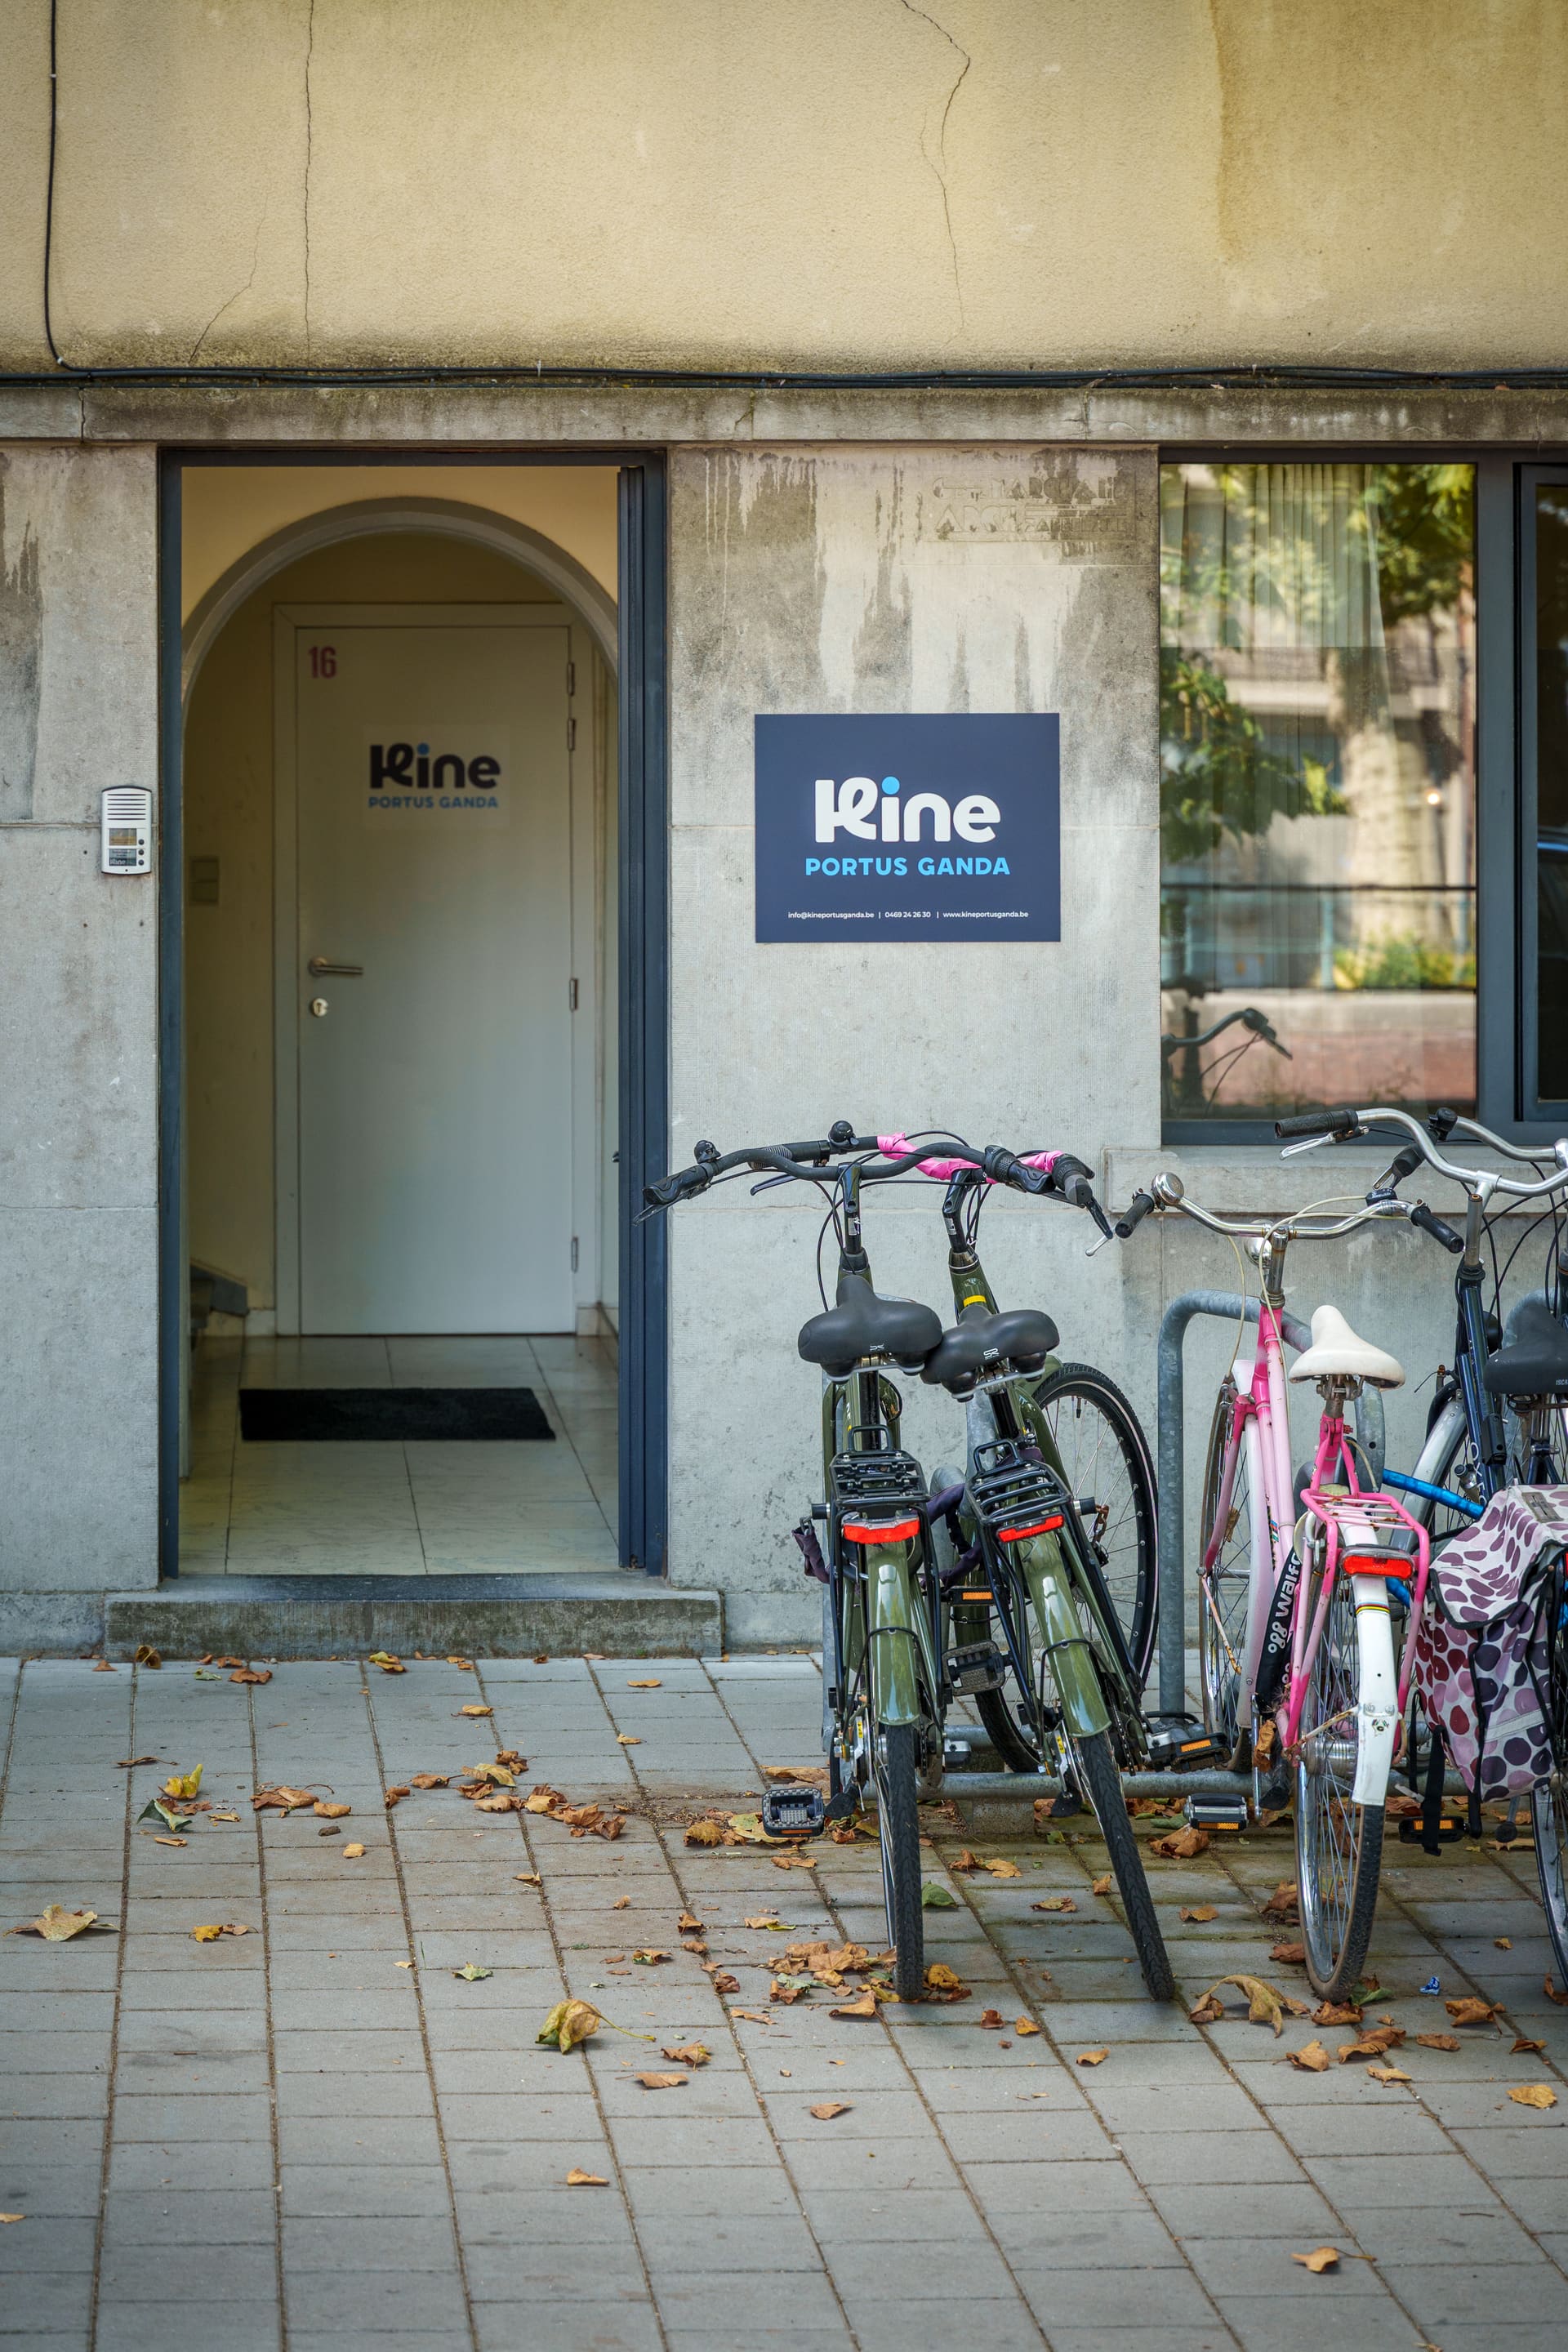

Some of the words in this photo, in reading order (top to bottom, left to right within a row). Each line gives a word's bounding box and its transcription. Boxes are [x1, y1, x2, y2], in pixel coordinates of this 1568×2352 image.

[309, 646, 337, 679] 16
[369, 742, 501, 790] Kine
[368, 796, 434, 808] PORTUS
[439, 796, 498, 808] GANDA
[814, 776, 1001, 843] Kine
[805, 858, 907, 876] PORTUS
[918, 857, 1010, 876] GANDA
[787, 911, 875, 920] info@kineportusganda.be
[942, 911, 1029, 919] www.kineportusganda.be
